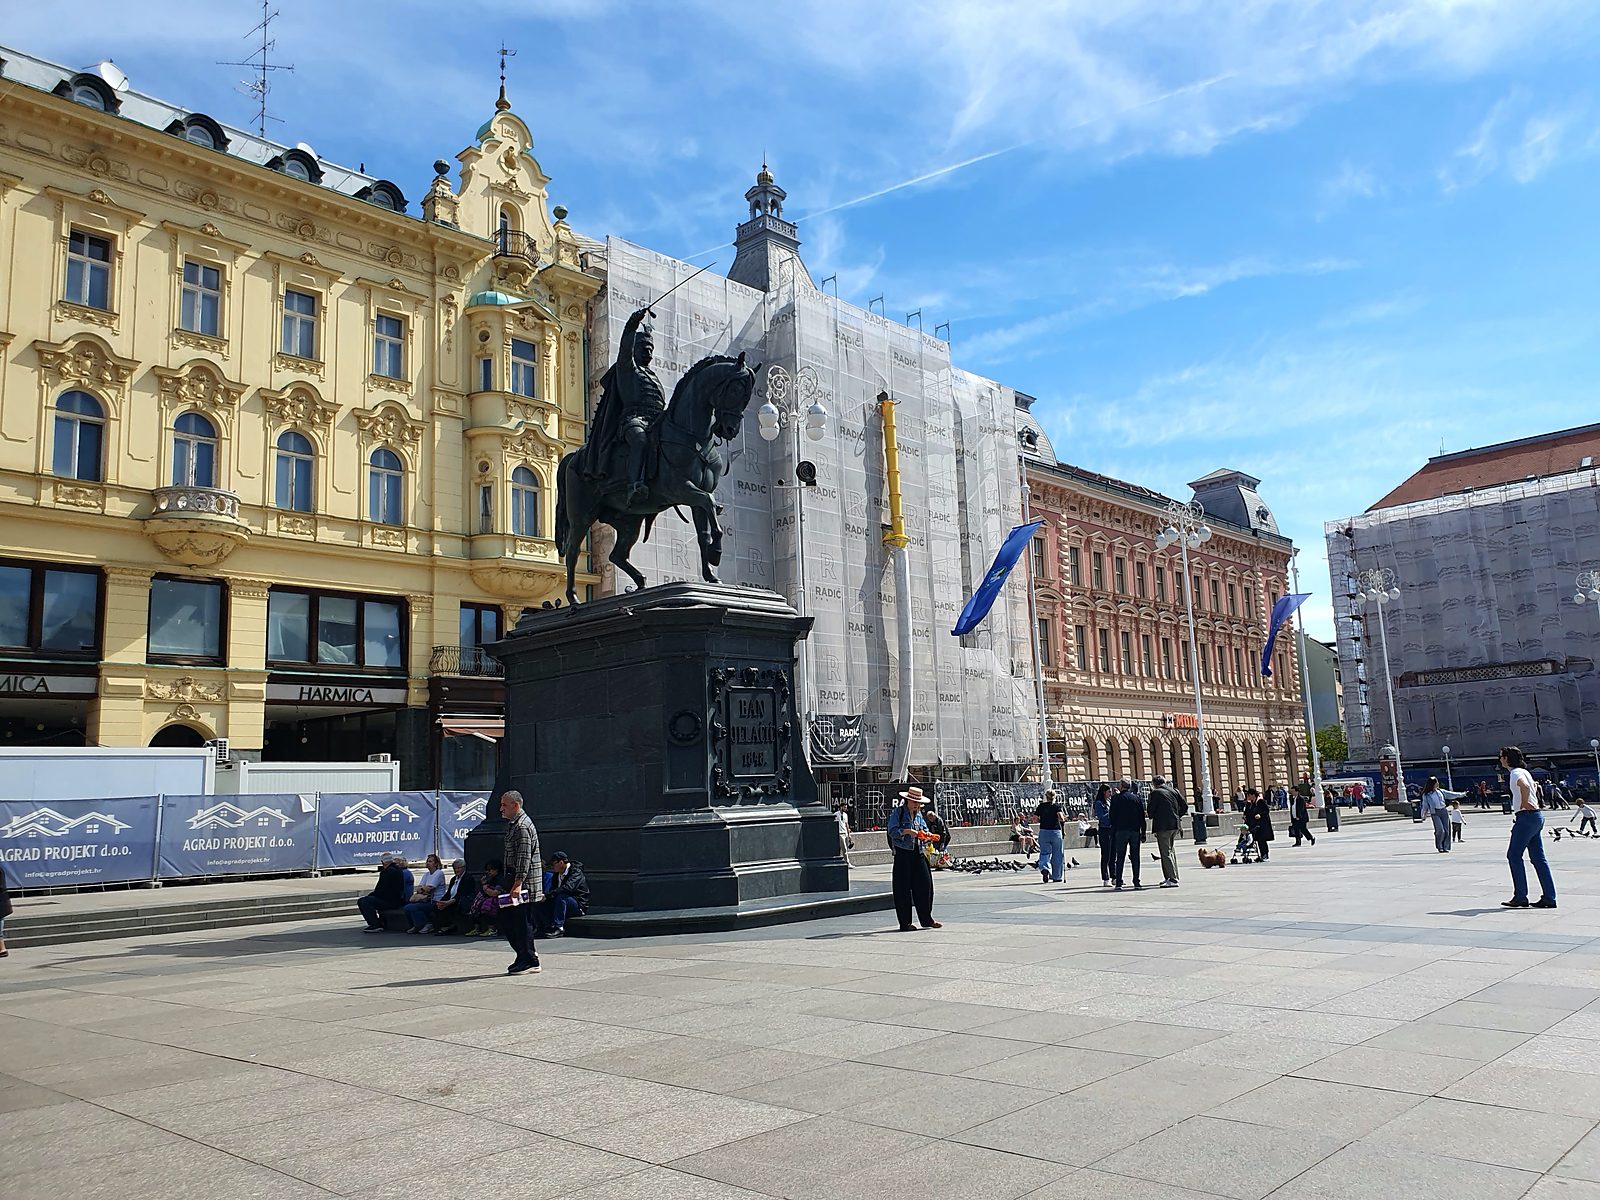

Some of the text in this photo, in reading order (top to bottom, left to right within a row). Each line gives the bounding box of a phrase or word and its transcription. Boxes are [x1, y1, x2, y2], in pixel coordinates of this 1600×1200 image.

[737, 480, 768, 495] RADIĆ
[775, 511, 806, 529] RADĆ
[844, 522, 871, 537] RADIĆ
[815, 586, 842, 600] RADIĆ
[848, 621, 875, 635] RADIĆ
[300, 686, 374, 702] HARMICA
[820, 689, 846, 702] RADIĆ
[939, 691, 961, 703] RADIĆ
[739, 699, 765, 718] BAN
[991, 705, 1012, 716] RADIĆ
[839, 727, 861, 738] RADIĆ
[966, 796, 990, 809] RADIĆ
[182, 836, 295, 851] AGRAD PROJEKT d.o.o.
[334, 831, 421, 844] AGRAD PROJEKT d.o.o.
[44, 844, 98, 861] PROJEKT
[101, 845, 132, 857] d.o.o.
[207, 857, 271, 866] info@agradprojekt.hr
[24, 868, 103, 878] info@agradprojekt.hr
